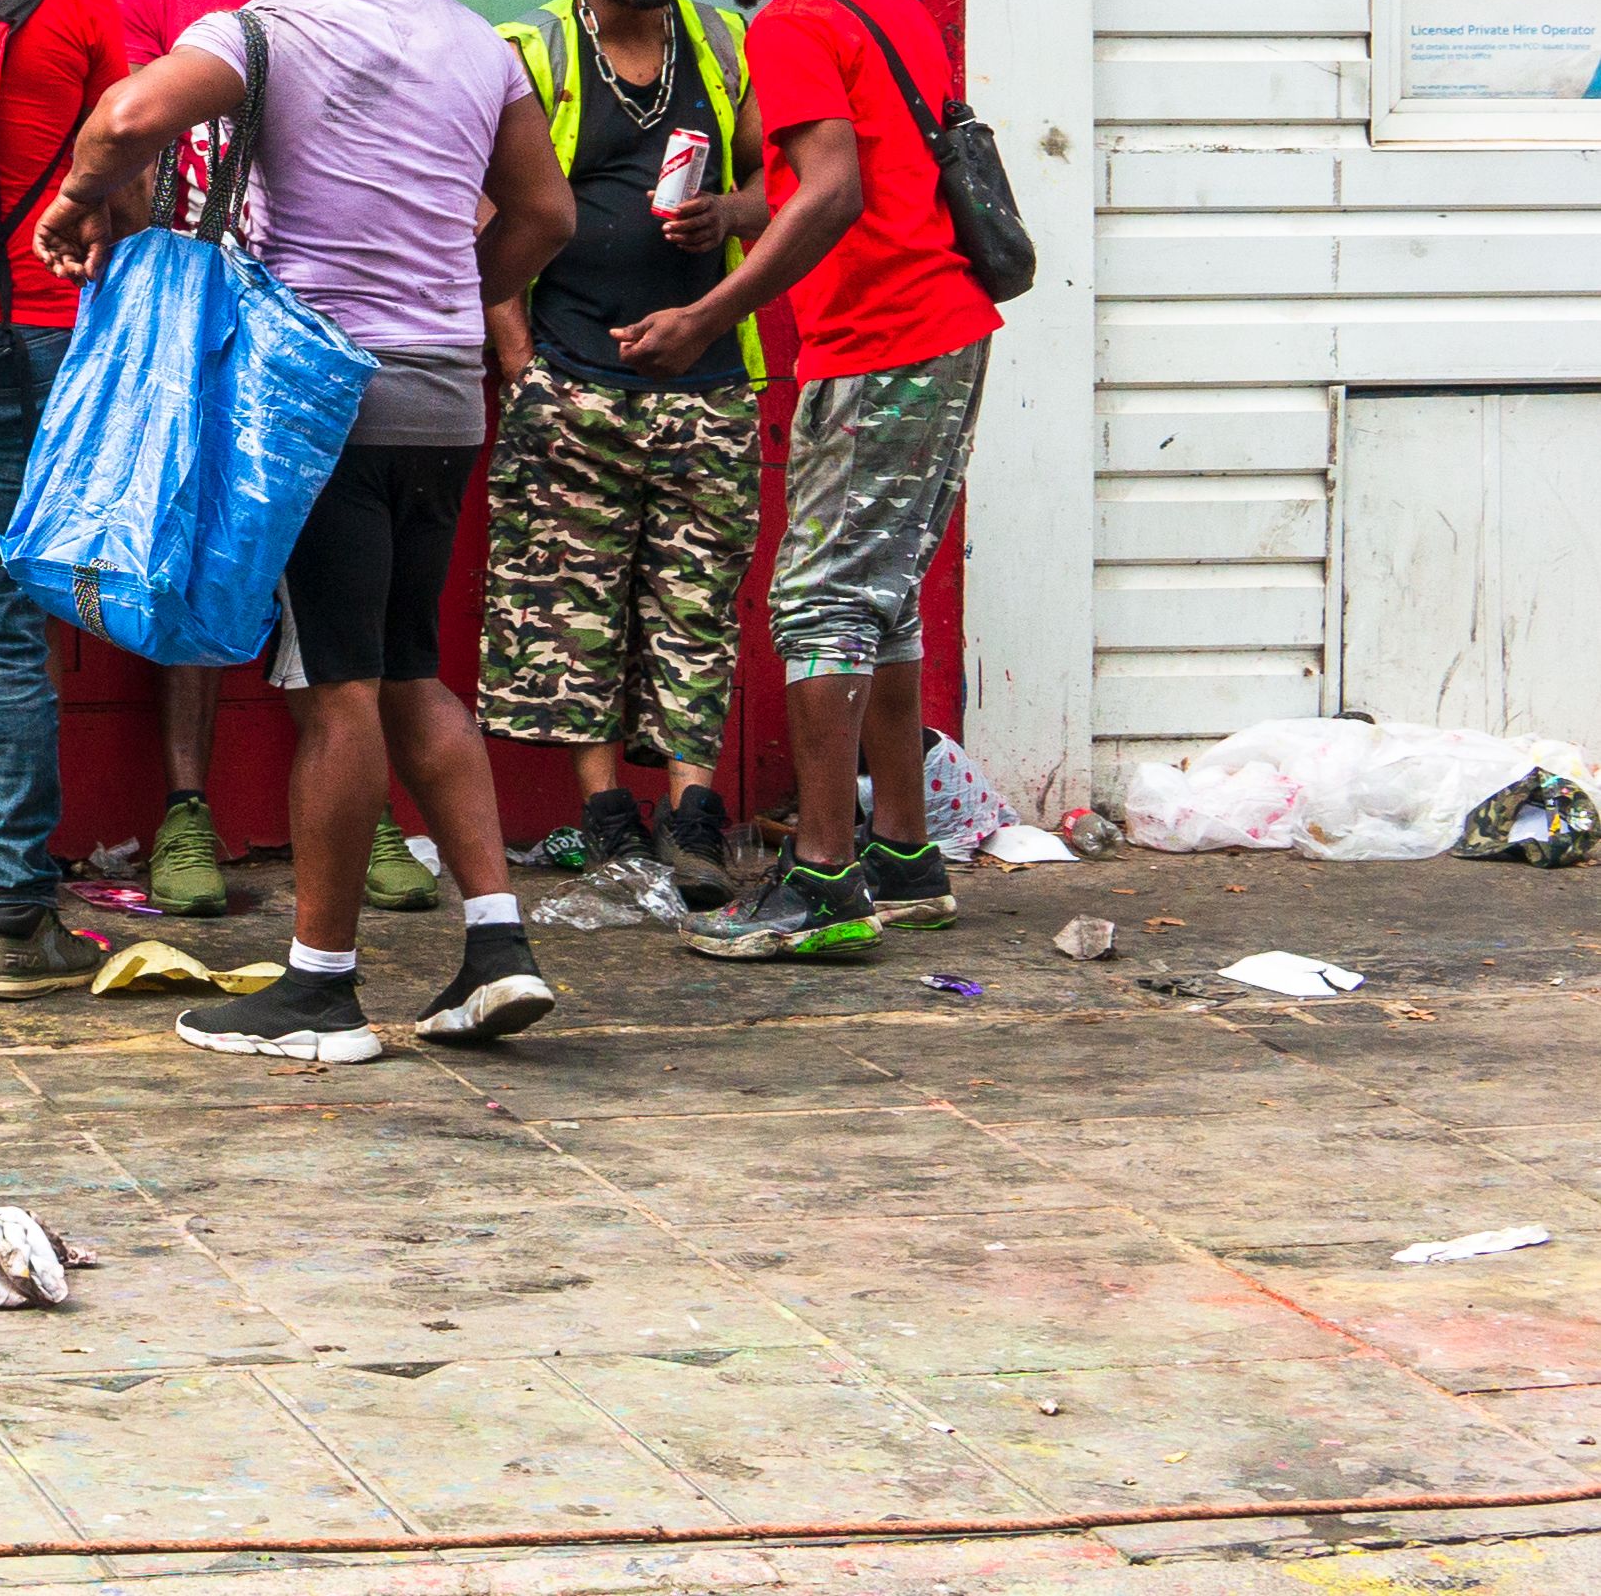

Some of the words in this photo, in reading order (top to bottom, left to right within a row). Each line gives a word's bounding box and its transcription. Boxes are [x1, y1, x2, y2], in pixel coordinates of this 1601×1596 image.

[1411, 24, 1464, 36] Licensed
[1468, 24, 1509, 36] Private
[1513, 25, 1538, 36] Hire
[1541, 25, 1596, 40] Operator
[4, 953, 40, 968] FILA
